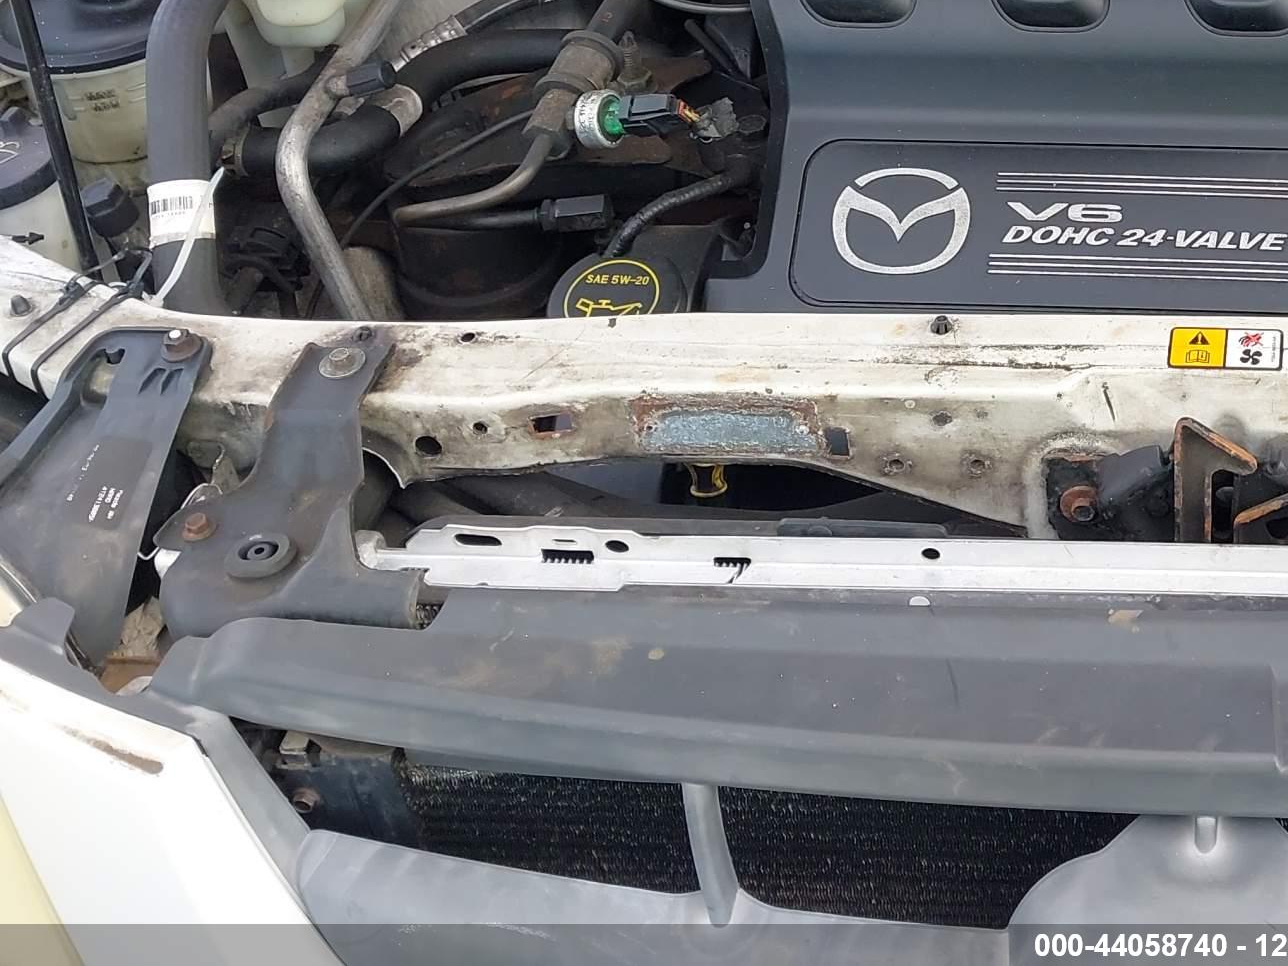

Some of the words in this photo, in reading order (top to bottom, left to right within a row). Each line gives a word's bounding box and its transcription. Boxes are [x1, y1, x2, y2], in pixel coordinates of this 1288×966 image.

[1007, 201, 1123, 223] V6
[1002, 225, 1115, 246] DOHC
[1116, 228, 1288, 251] 24-VALVE
[585, 274, 610, 285] SAE
[610, 274, 651, 286] 5W-20
